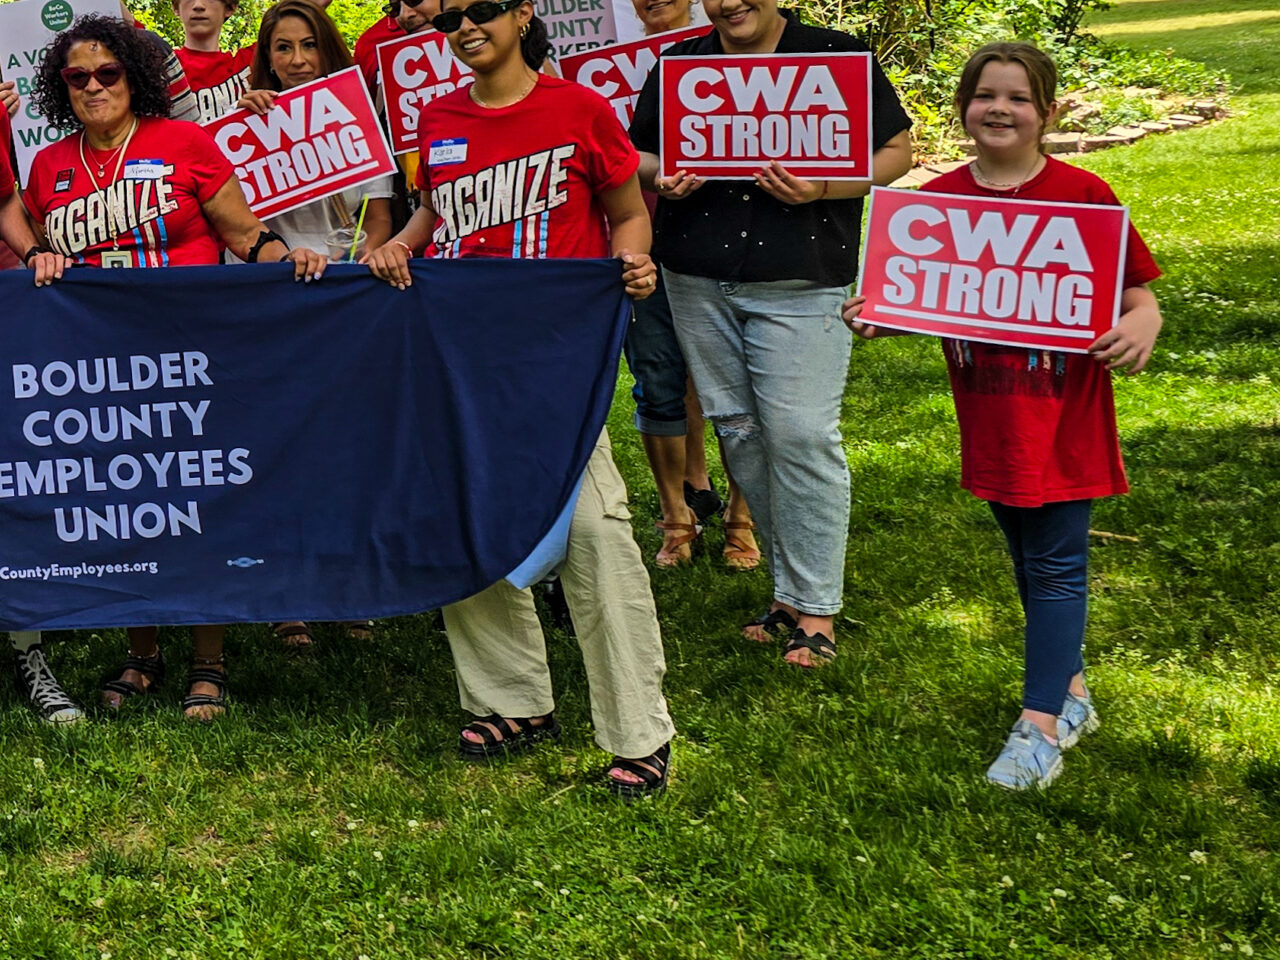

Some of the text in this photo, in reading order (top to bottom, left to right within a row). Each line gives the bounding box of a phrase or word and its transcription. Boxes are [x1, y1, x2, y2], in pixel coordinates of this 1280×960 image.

[546, 16, 604, 40] UNTY
[7, 53, 21, 70] A
[392, 37, 473, 89] CW
[577, 41, 676, 98] CW
[677, 64, 849, 114] CWA
[214, 87, 357, 166] CWA
[679, 113, 851, 159] STRONG
[888, 203, 1095, 273] CWA
[882, 255, 1095, 327] STRONG
[12, 350, 214, 399] BOULDER
[22, 400, 211, 447] COUNTY
[53, 501, 203, 543] UNION
